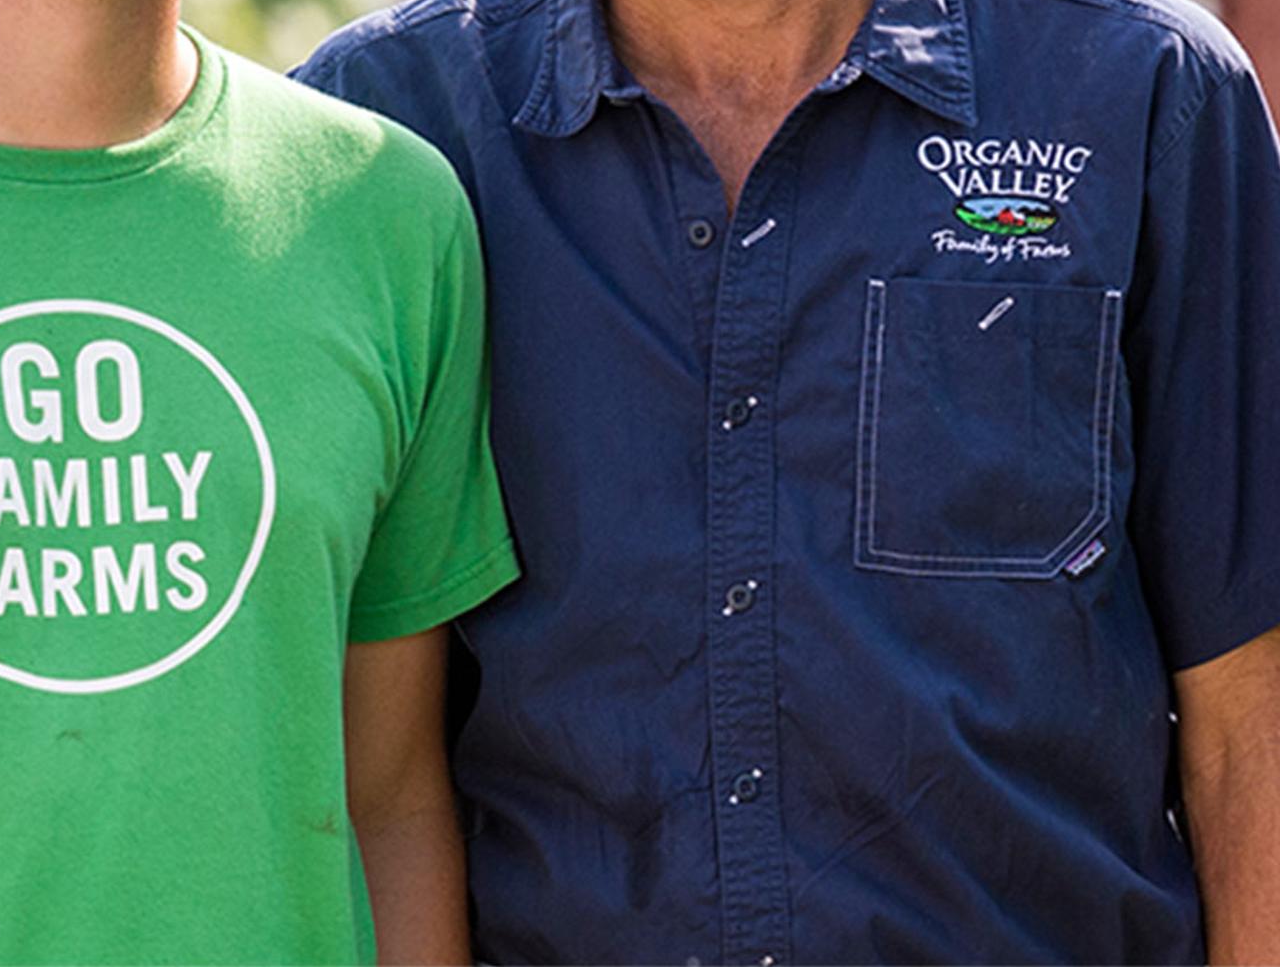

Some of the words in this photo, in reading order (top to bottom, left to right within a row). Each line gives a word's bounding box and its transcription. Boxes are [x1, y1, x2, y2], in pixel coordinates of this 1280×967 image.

[917, 135, 1093, 173] ORGANIC
[938, 168, 1076, 204] VALLEY
[930, 229, 999, 264] Family
[1001, 236, 1018, 262] of
[1017, 236, 1071, 260] Farms
[0, 339, 143, 444] GO
